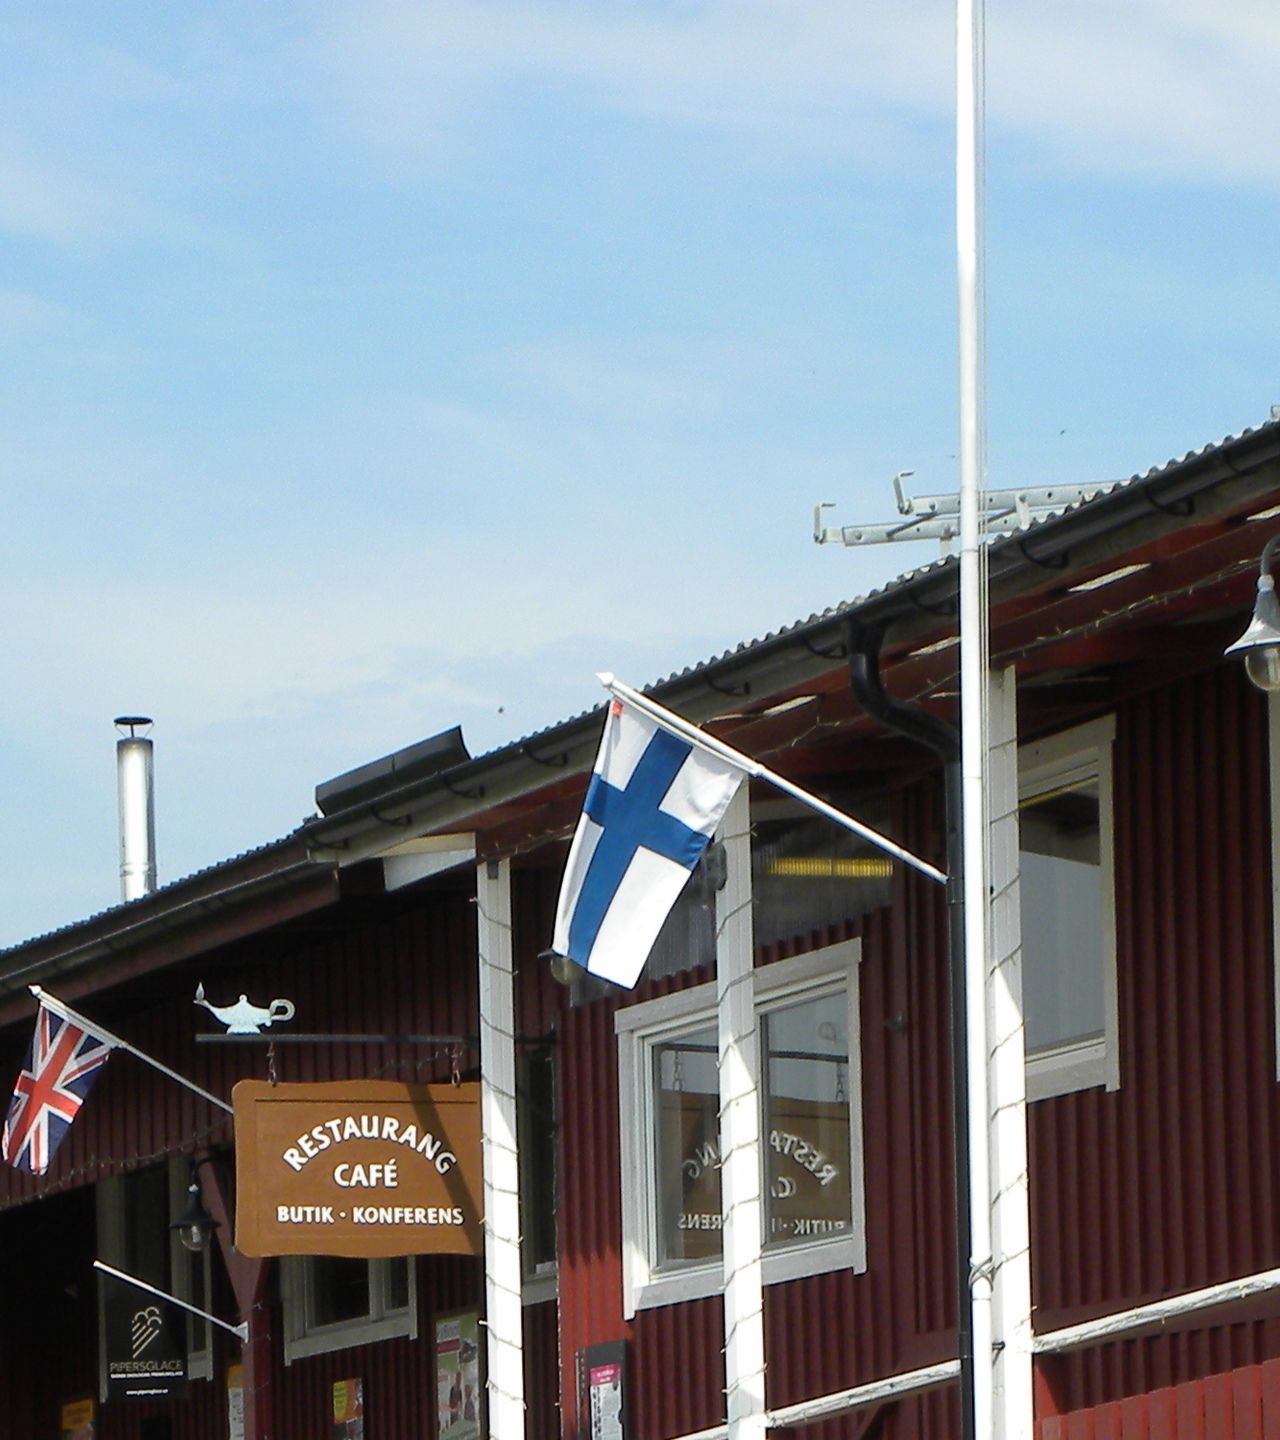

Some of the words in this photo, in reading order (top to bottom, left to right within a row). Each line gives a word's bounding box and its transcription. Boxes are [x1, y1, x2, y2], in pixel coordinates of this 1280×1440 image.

[282, 1114, 458, 1175] RESTAURANG
[333, 1158, 399, 1188] CAFÉ
[276, 1205, 336, 1224] BUTIK
[352, 1206, 465, 1226] KONFERENS
